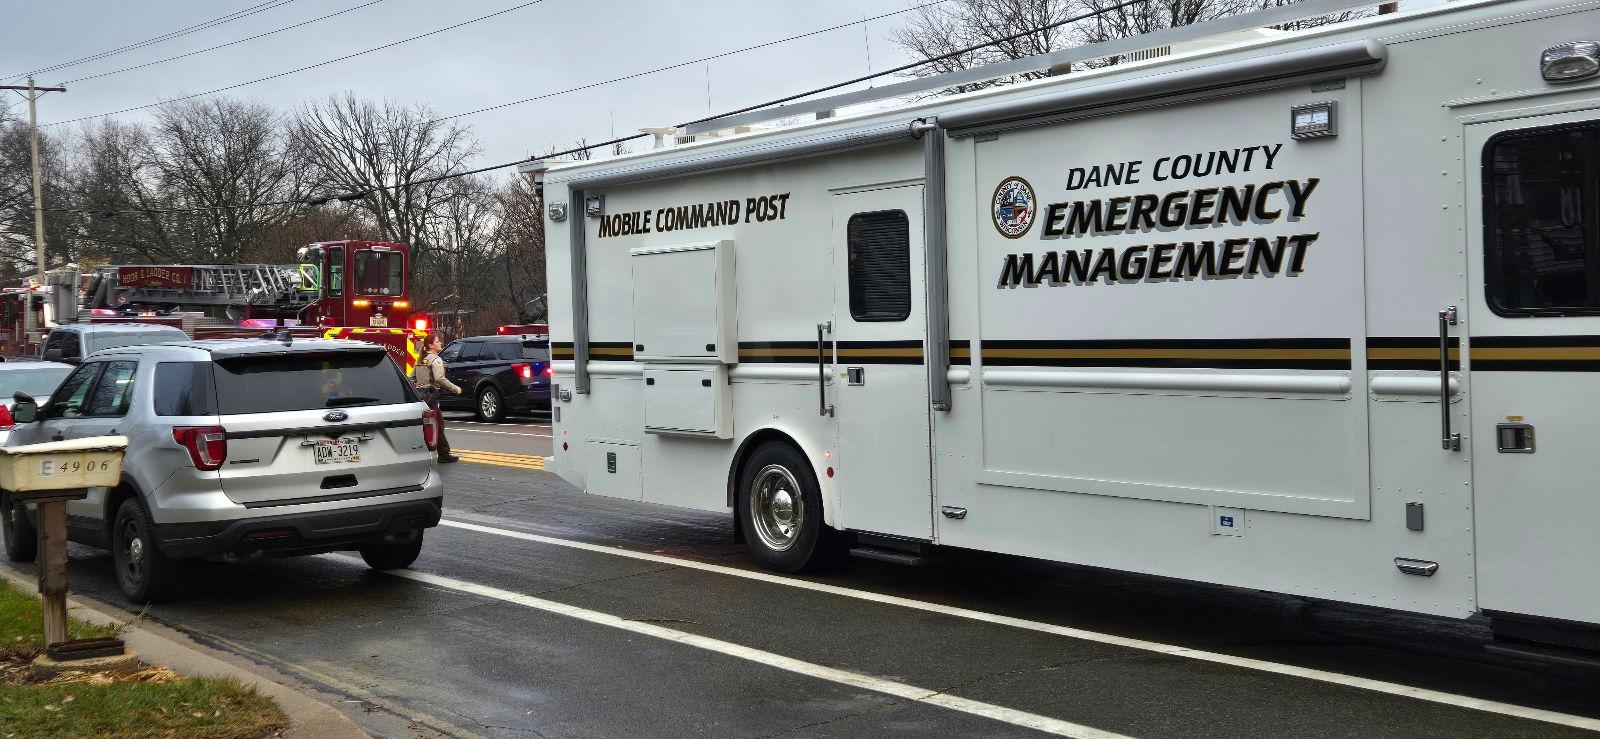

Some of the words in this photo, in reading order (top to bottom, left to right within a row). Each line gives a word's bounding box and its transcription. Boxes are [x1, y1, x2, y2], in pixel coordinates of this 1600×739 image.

[1066, 160, 1143, 190] DANE
[1152, 143, 1283, 182] COUNTY
[598, 210, 652, 238] MOBILE
[656, 200, 741, 232] COMMAND
[745, 192, 791, 223] POST
[1040, 177, 1321, 240] EMERGENCY
[146, 267, 170, 280] LADDER
[997, 232, 1321, 289] MANAGEMENT
[41, 460, 53, 476] E
[60, 460, 111, 472] 4906
